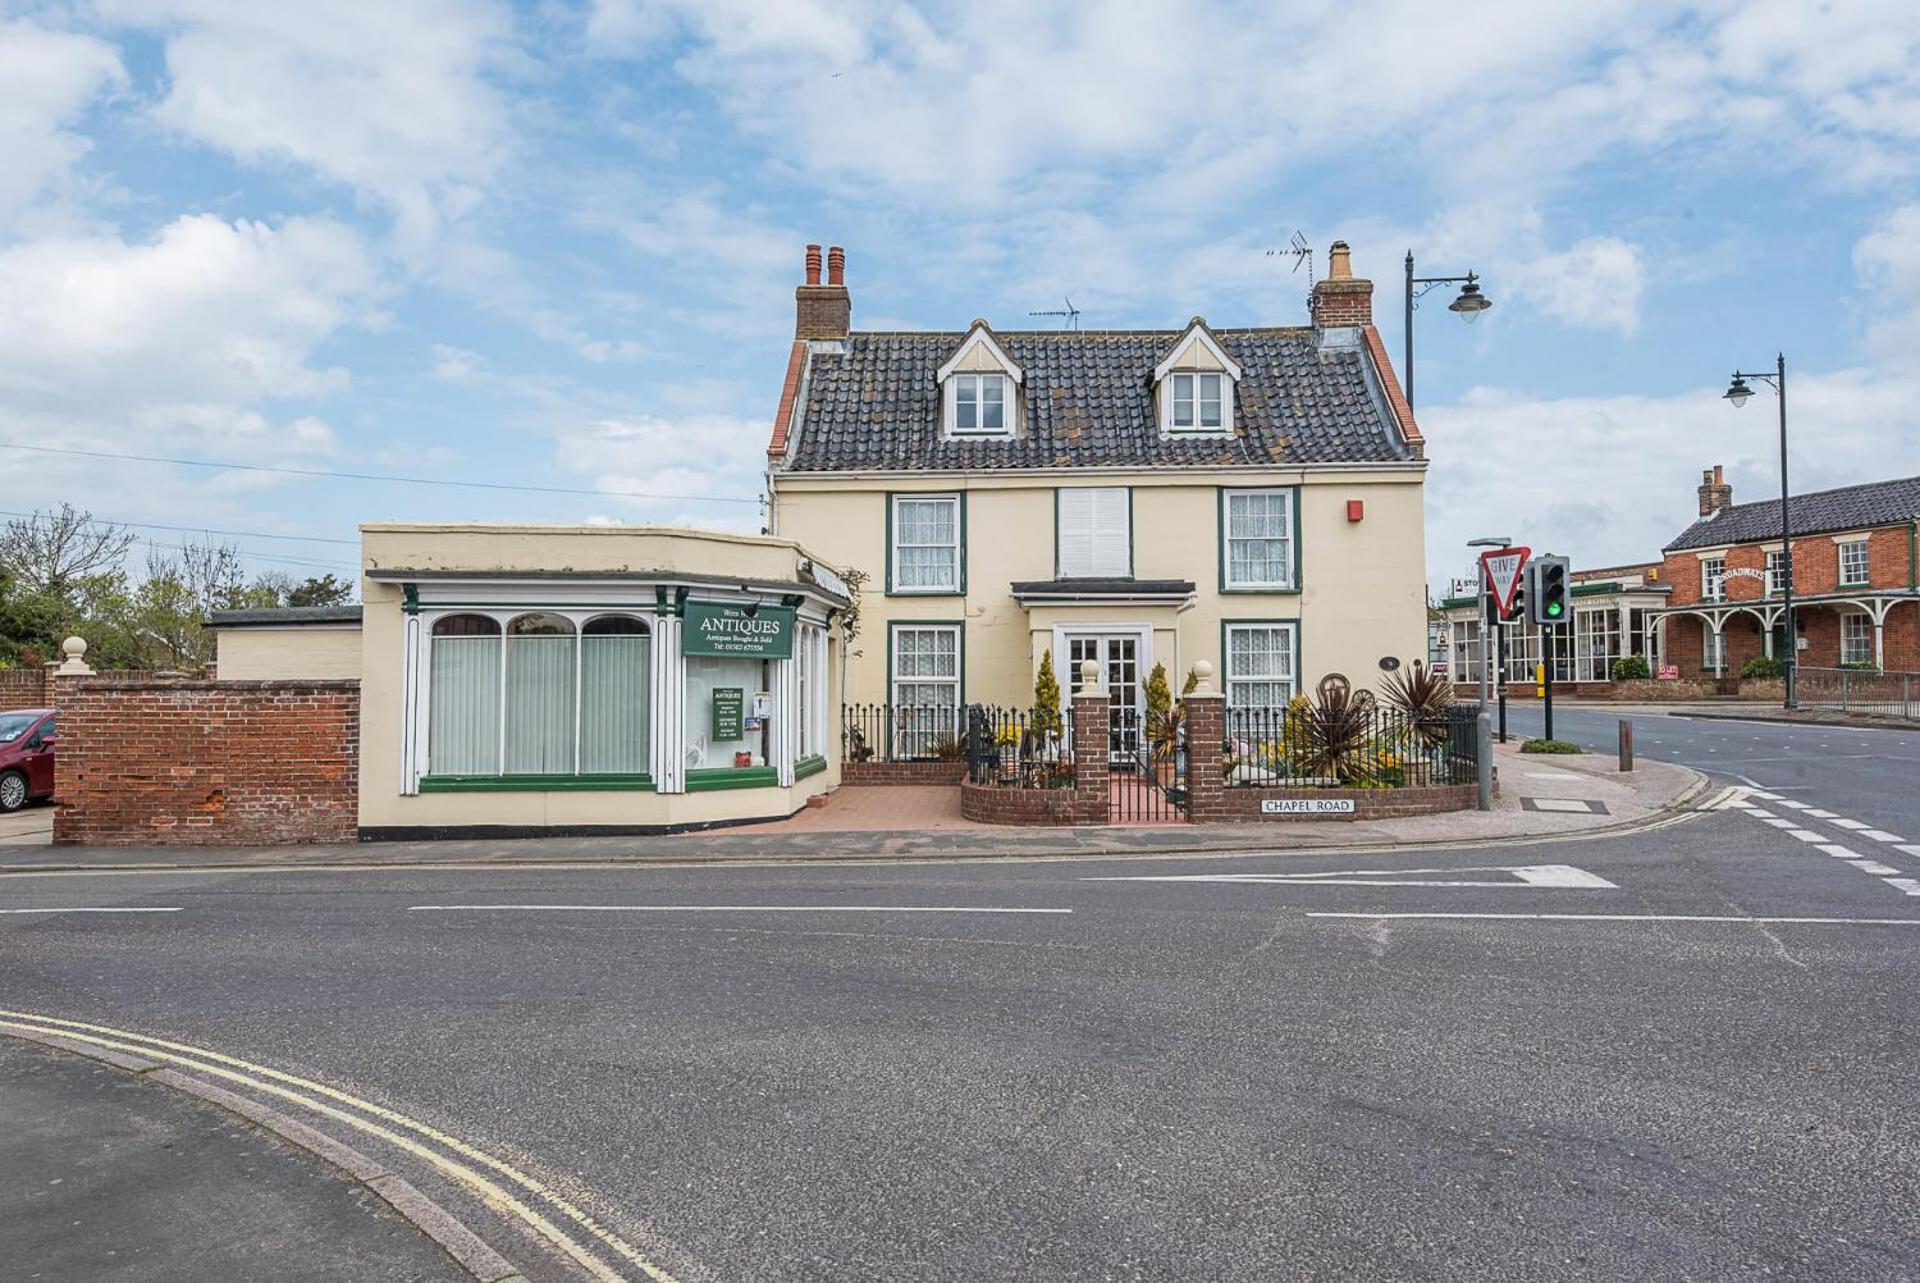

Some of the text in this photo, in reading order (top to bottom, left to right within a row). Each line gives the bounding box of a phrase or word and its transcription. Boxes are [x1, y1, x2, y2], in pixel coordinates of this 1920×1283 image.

[1490, 558, 1516, 573] GIVE
[1494, 575, 1511, 585] WAY
[700, 618, 780, 635] ANTIQUES
[1265, 801, 1350, 811] CHAPEL ROAD
